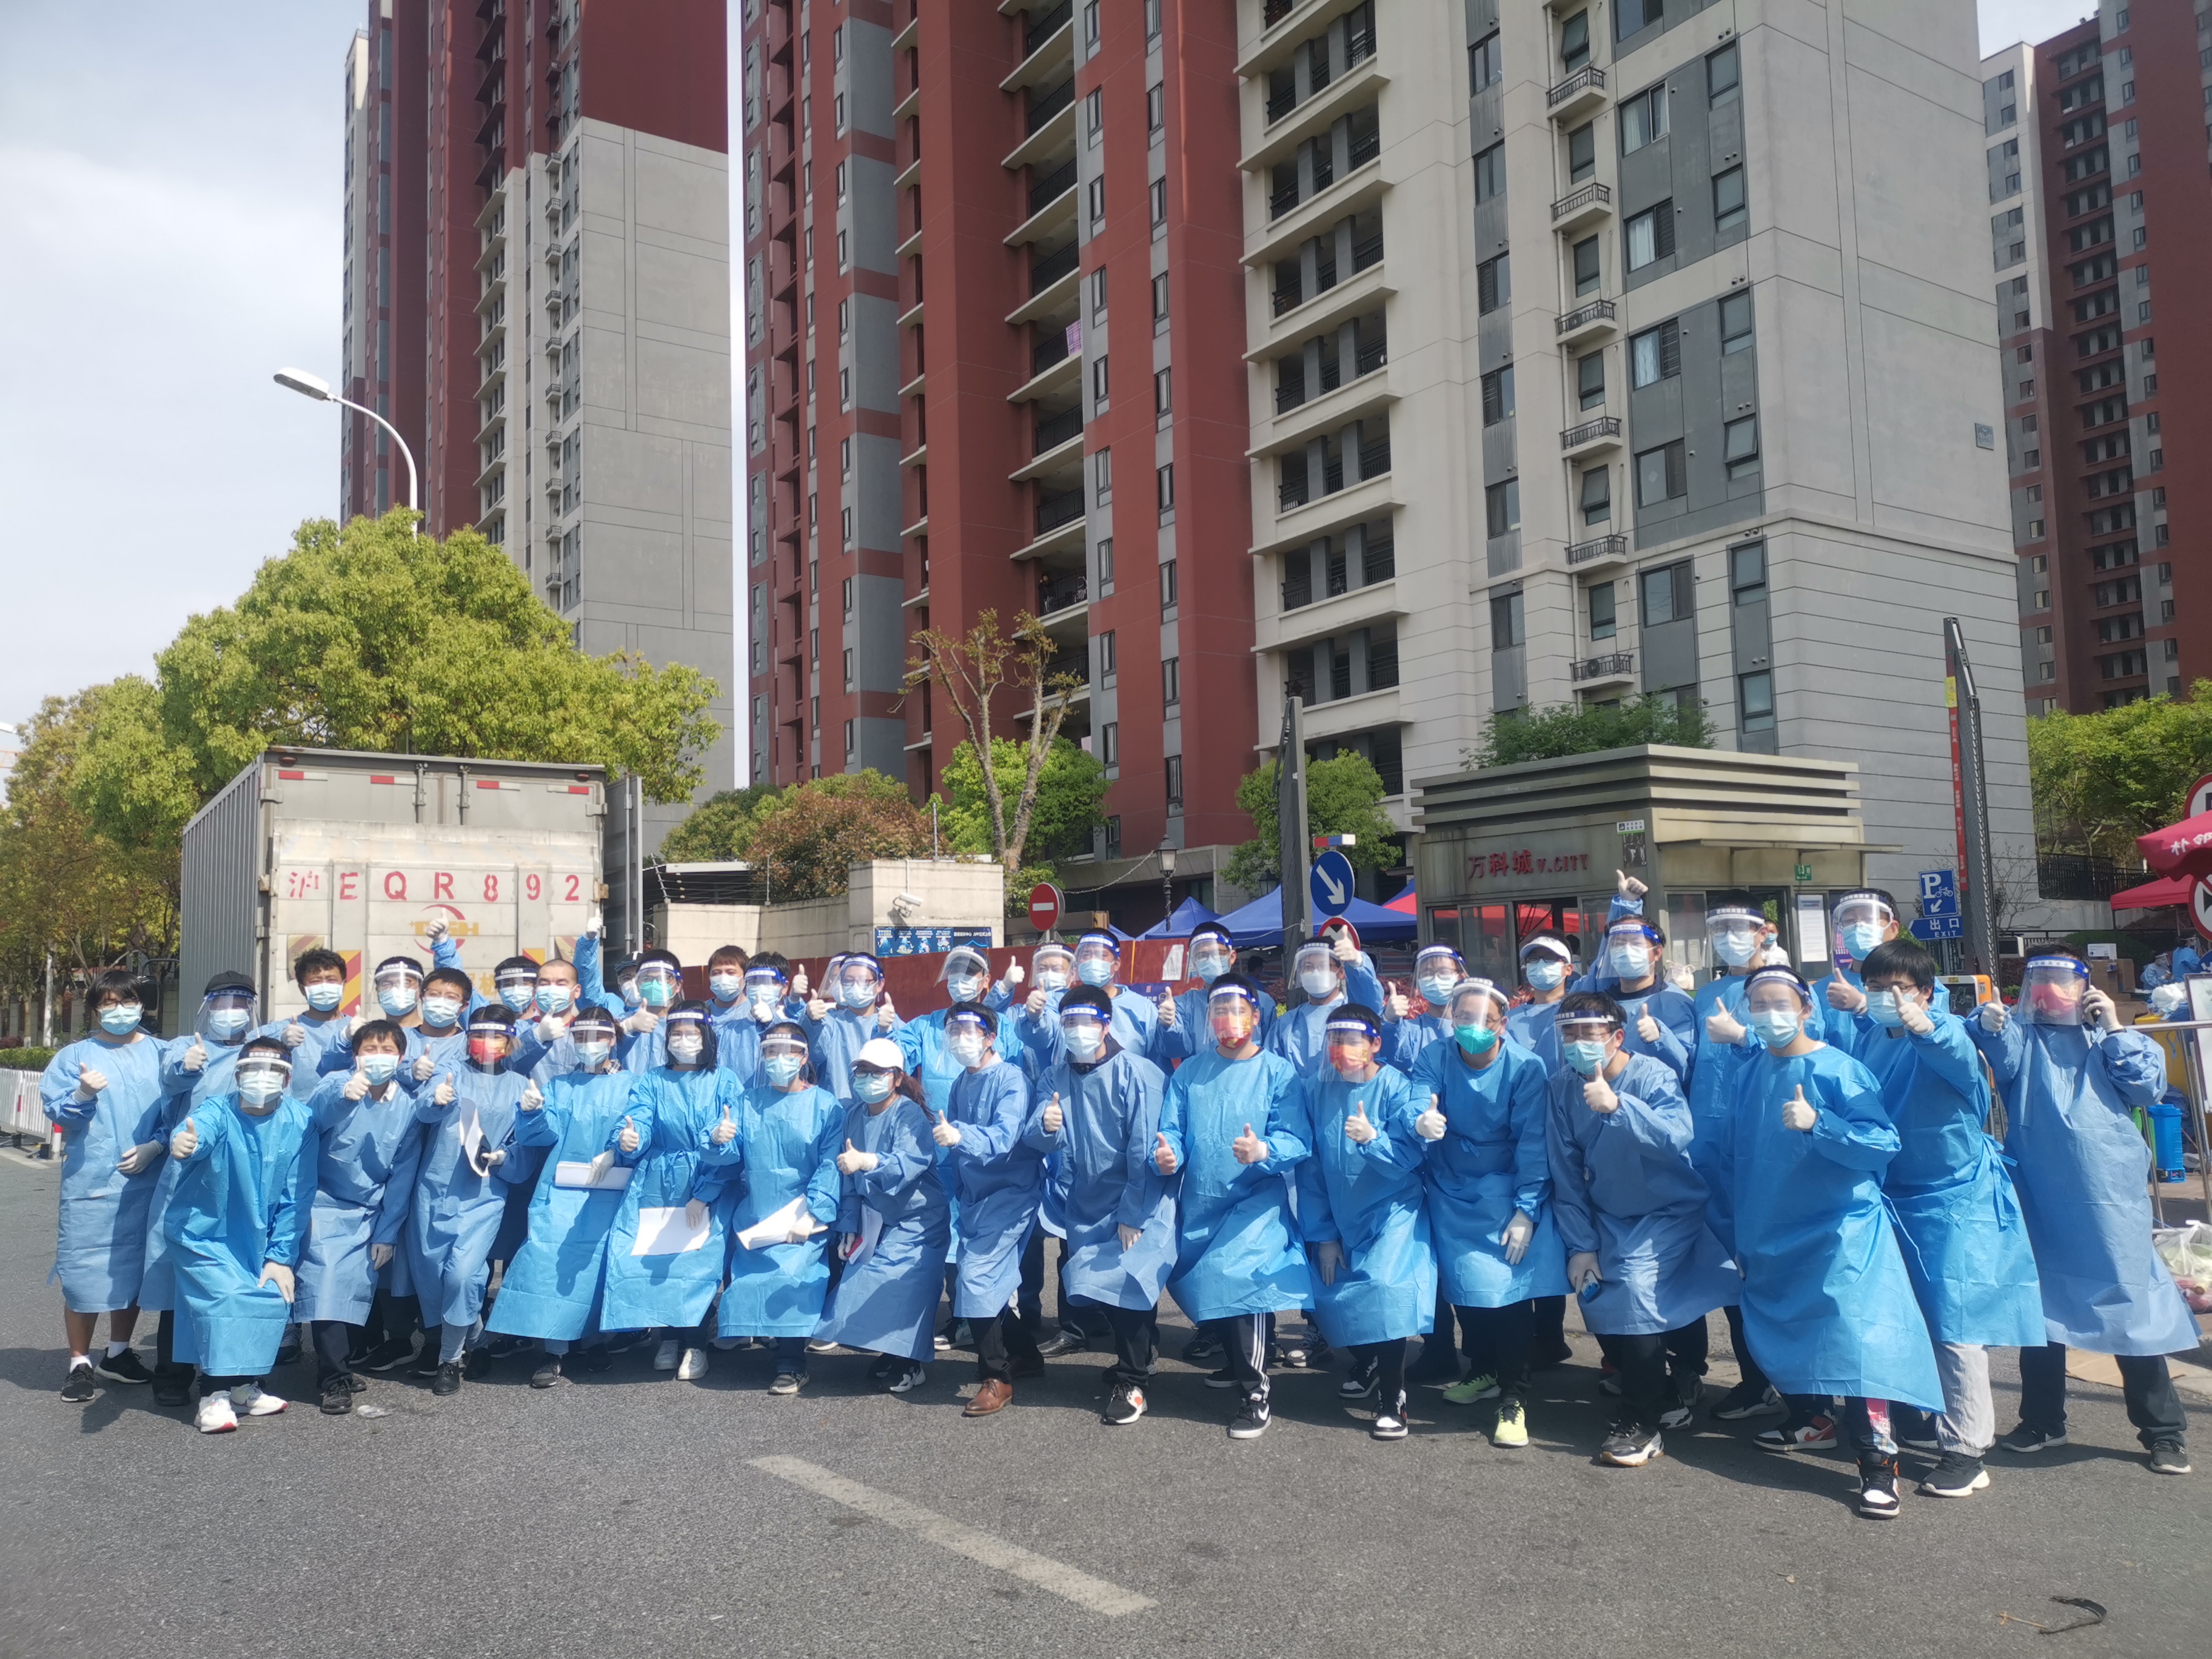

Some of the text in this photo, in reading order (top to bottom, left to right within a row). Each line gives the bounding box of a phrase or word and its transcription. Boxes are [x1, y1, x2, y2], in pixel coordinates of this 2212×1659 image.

[1468, 849, 1533, 879] 万科城
[1922, 874, 1942, 899] P
[1930, 918, 1960, 930] 出口
